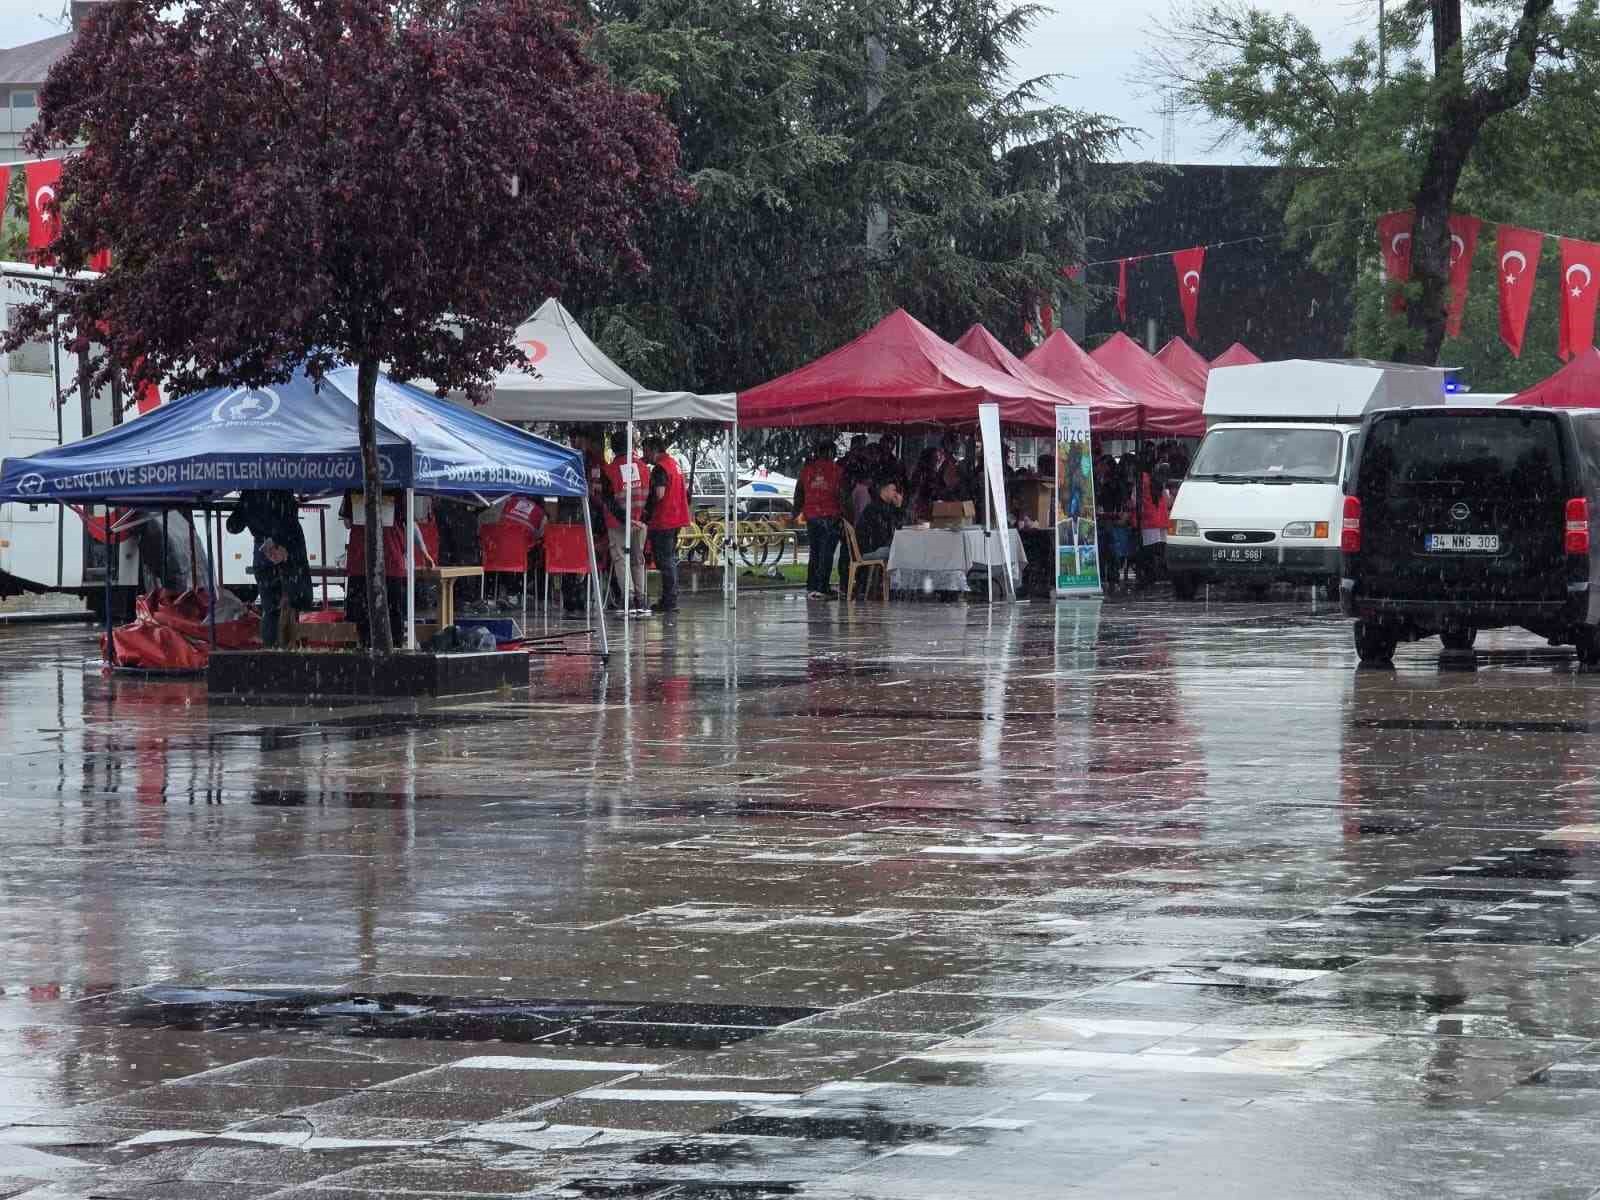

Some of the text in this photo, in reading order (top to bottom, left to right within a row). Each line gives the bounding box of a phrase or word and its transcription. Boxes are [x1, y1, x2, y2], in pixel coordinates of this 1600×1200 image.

[117, 465, 136, 486] VE
[139, 464, 177, 484] SPOR
[180, 457, 262, 481] HİZMETLERİ
[264, 456, 356, 479] MÜDÜRLÜĞÜ
[1432, 535, 1446, 548] 34
[1478, 536, 1497, 548] 303
